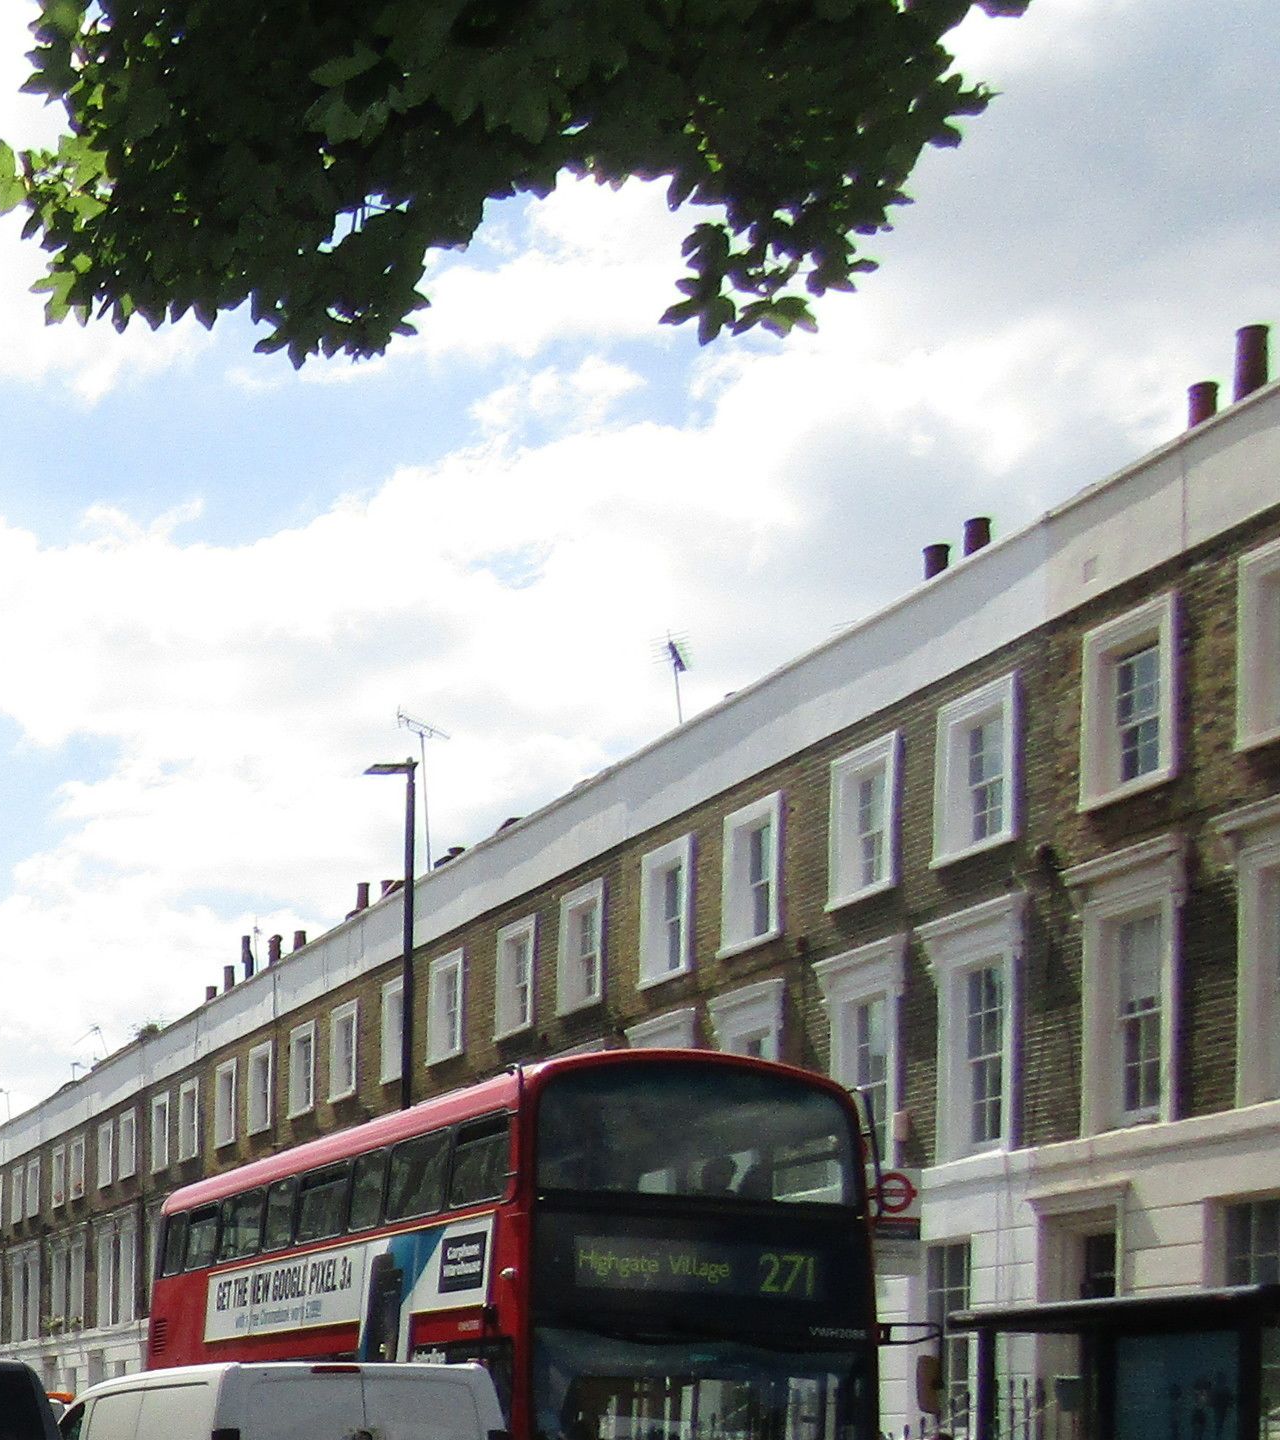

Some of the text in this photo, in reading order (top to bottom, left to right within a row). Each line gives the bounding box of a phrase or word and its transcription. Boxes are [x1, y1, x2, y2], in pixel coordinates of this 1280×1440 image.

[216, 1280, 232, 1312] GET
[233, 1276, 249, 1308] THE
[251, 1271, 272, 1305] NEW
[272, 1263, 308, 1301] GOOGLE
[309, 1258, 338, 1295] PIXEL
[578, 1248, 732, 1284] Highgate Village
[758, 1252, 816, 1297] 271
